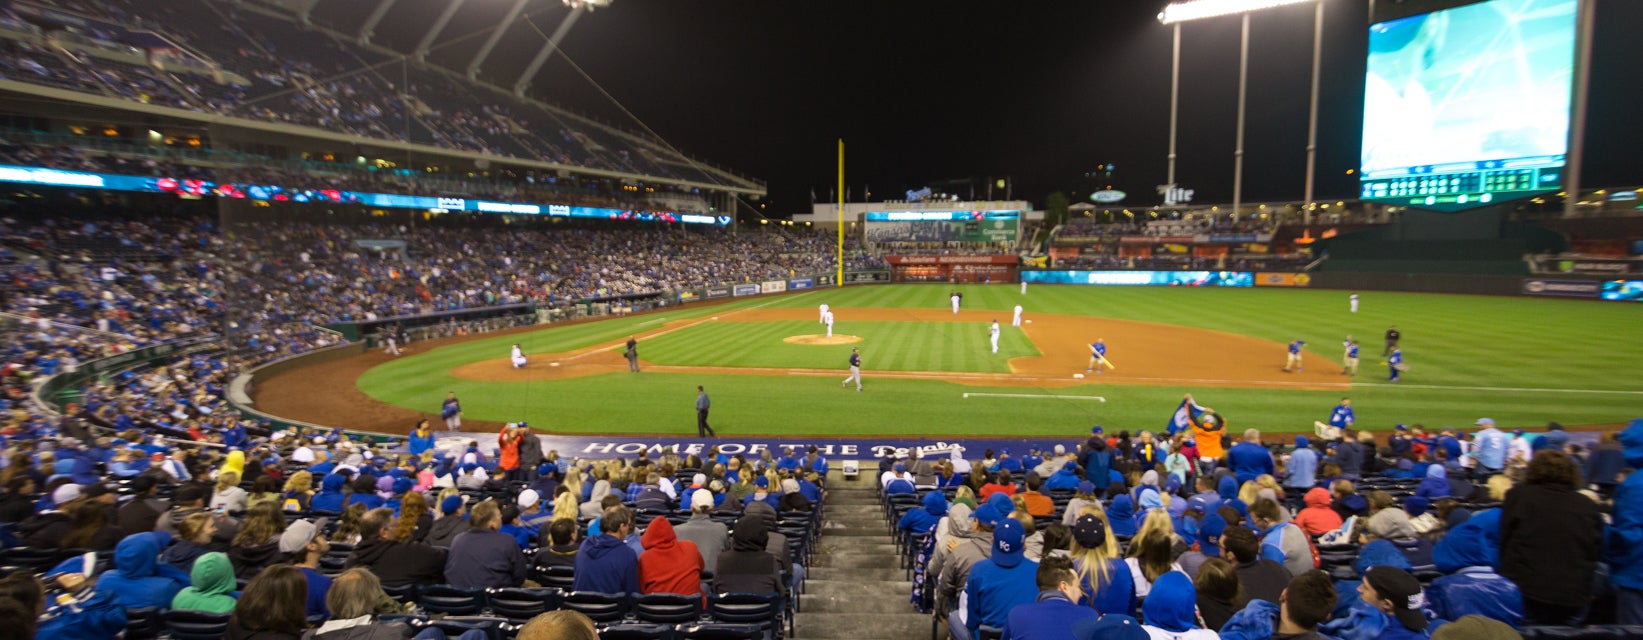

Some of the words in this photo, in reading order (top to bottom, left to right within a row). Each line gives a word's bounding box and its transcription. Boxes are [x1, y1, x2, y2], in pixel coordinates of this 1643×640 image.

[1164, 188, 1194, 205] Lite
[583, 443, 705, 454] HOME
[717, 443, 768, 455] OF
[779, 444, 859, 455] THE
[999, 540, 1010, 552] KC
